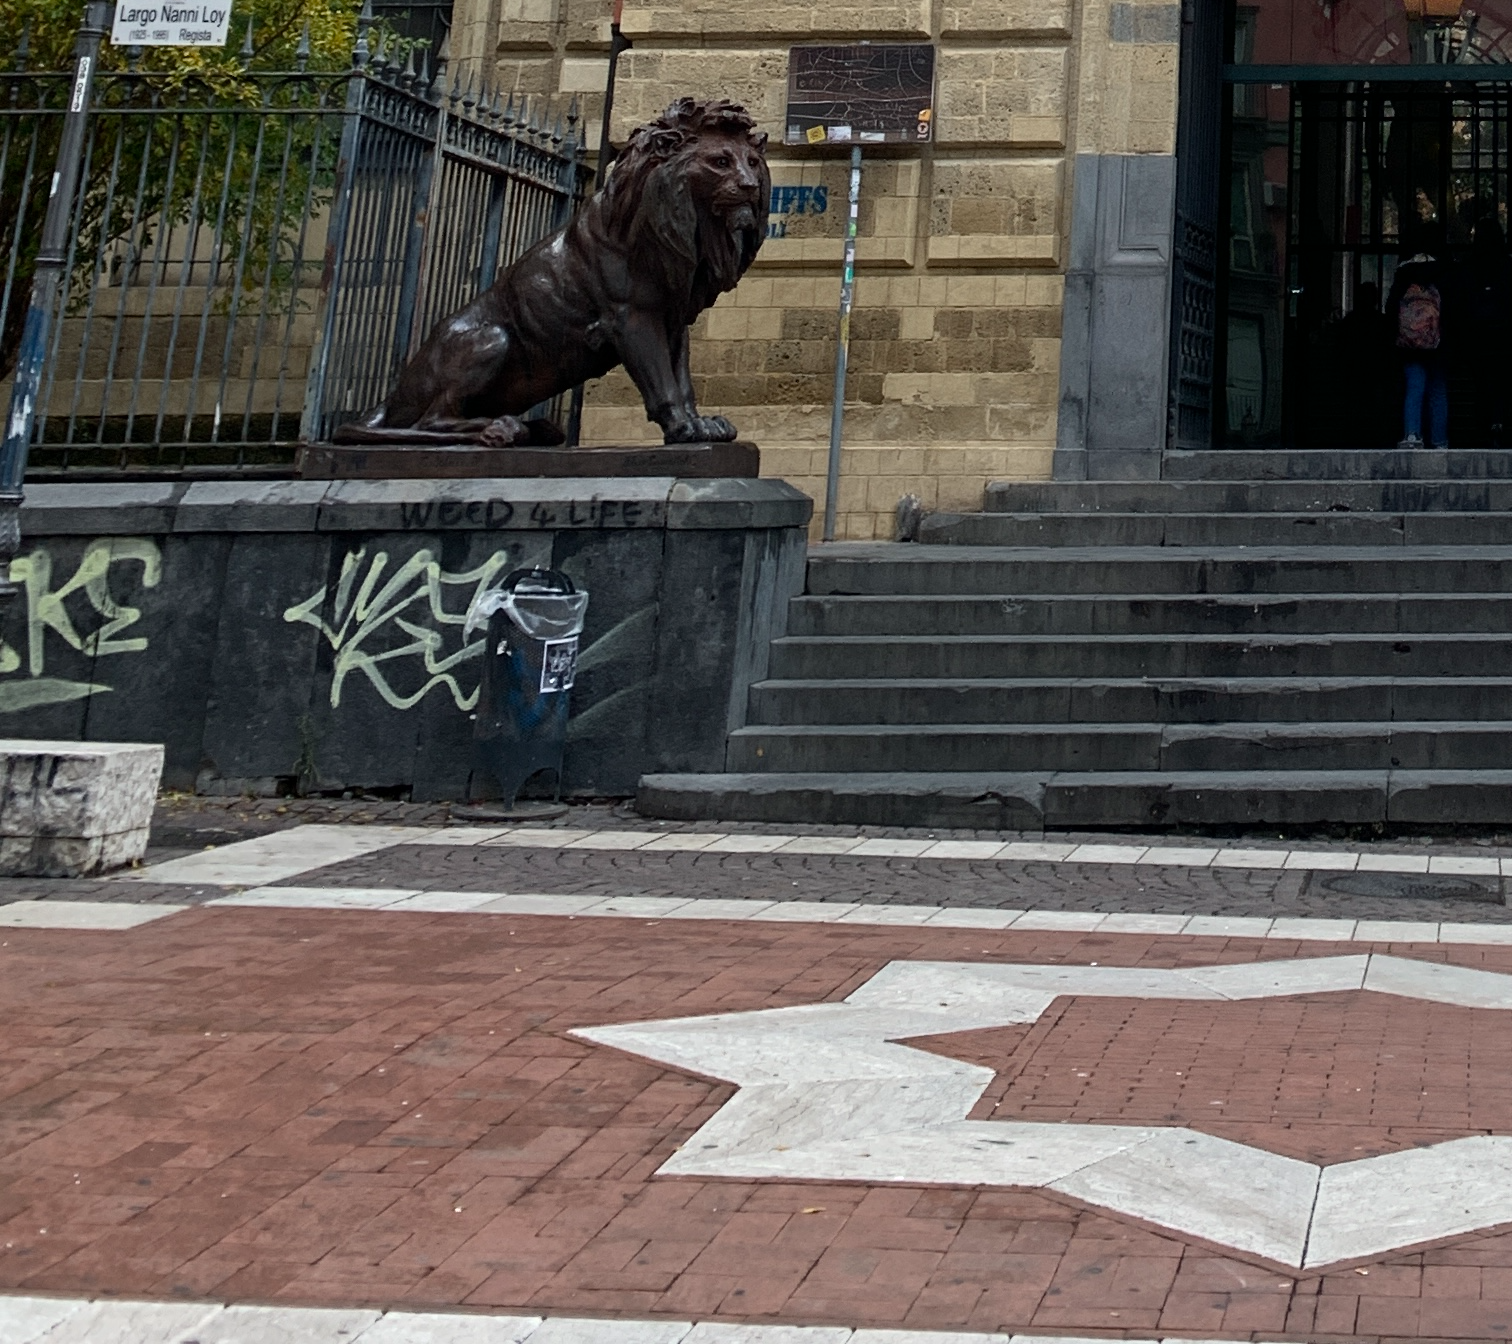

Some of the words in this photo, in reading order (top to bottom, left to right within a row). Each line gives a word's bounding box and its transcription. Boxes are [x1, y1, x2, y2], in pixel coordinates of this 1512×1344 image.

[120, 5, 157, 26] Largo
[160, 5, 199, 23] Nanni
[202, 6, 226, 27] Loy
[178, 28, 212, 43] Regista
[401, 498, 514, 529] WEED
[530, 502, 555, 528] 4
